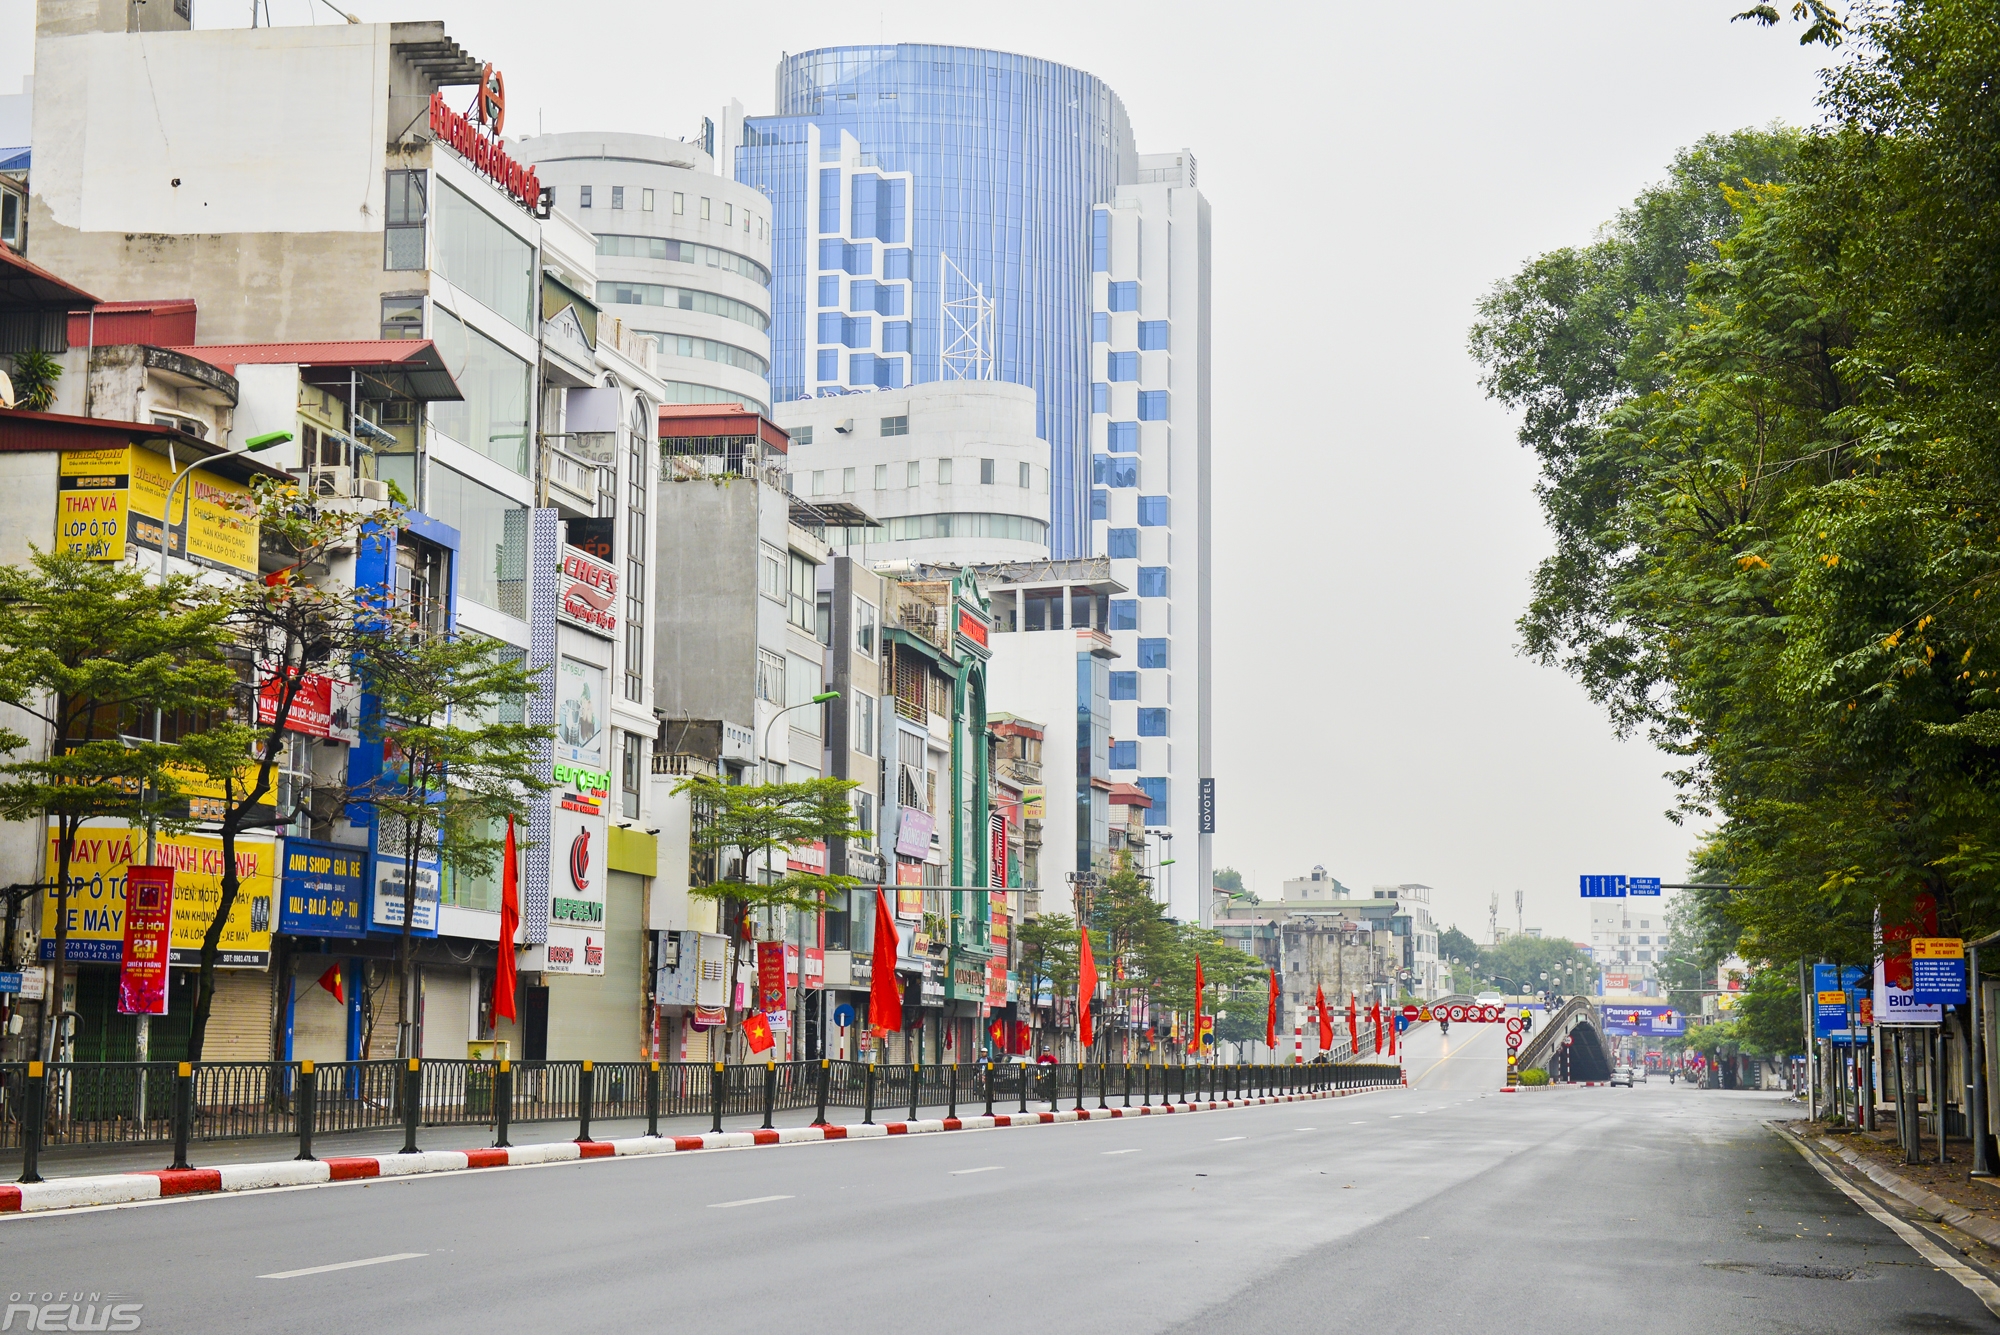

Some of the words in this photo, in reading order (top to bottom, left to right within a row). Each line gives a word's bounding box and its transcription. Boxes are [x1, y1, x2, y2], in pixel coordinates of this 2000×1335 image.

[134, 465, 183, 494] Blackgd
[66, 497, 98, 512] THAY
[101, 493, 117, 511] VÁ
[89, 519, 98, 536] Ô
[101, 518, 117, 536] TÔ
[554, 763, 609, 792] eurosun
[561, 800, 574, 811] MADE
[1203, 781, 1211, 830] NOVOTEL
[52, 838, 103, 864] TAY
[107, 834, 134, 864] VÁ
[157, 843, 197, 874] MINH
[202, 847, 258, 878] KHNH
[289, 854, 308, 872] ANH
[309, 856, 331, 874] SHOP
[333, 857, 347, 876] GIÁ
[89, 871, 103, 899] Ô
[83, 904, 124, 932] MÁY
[289, 896, 304, 914] VALI
[308, 898, 317, 915] BA
[318, 895, 327, 916] LÔ
[349, 898, 358, 918] TÚI
[83, 941, 98, 951] Tây
[133, 939, 159, 954] 231
[548, 946, 574, 964] BOSCH
